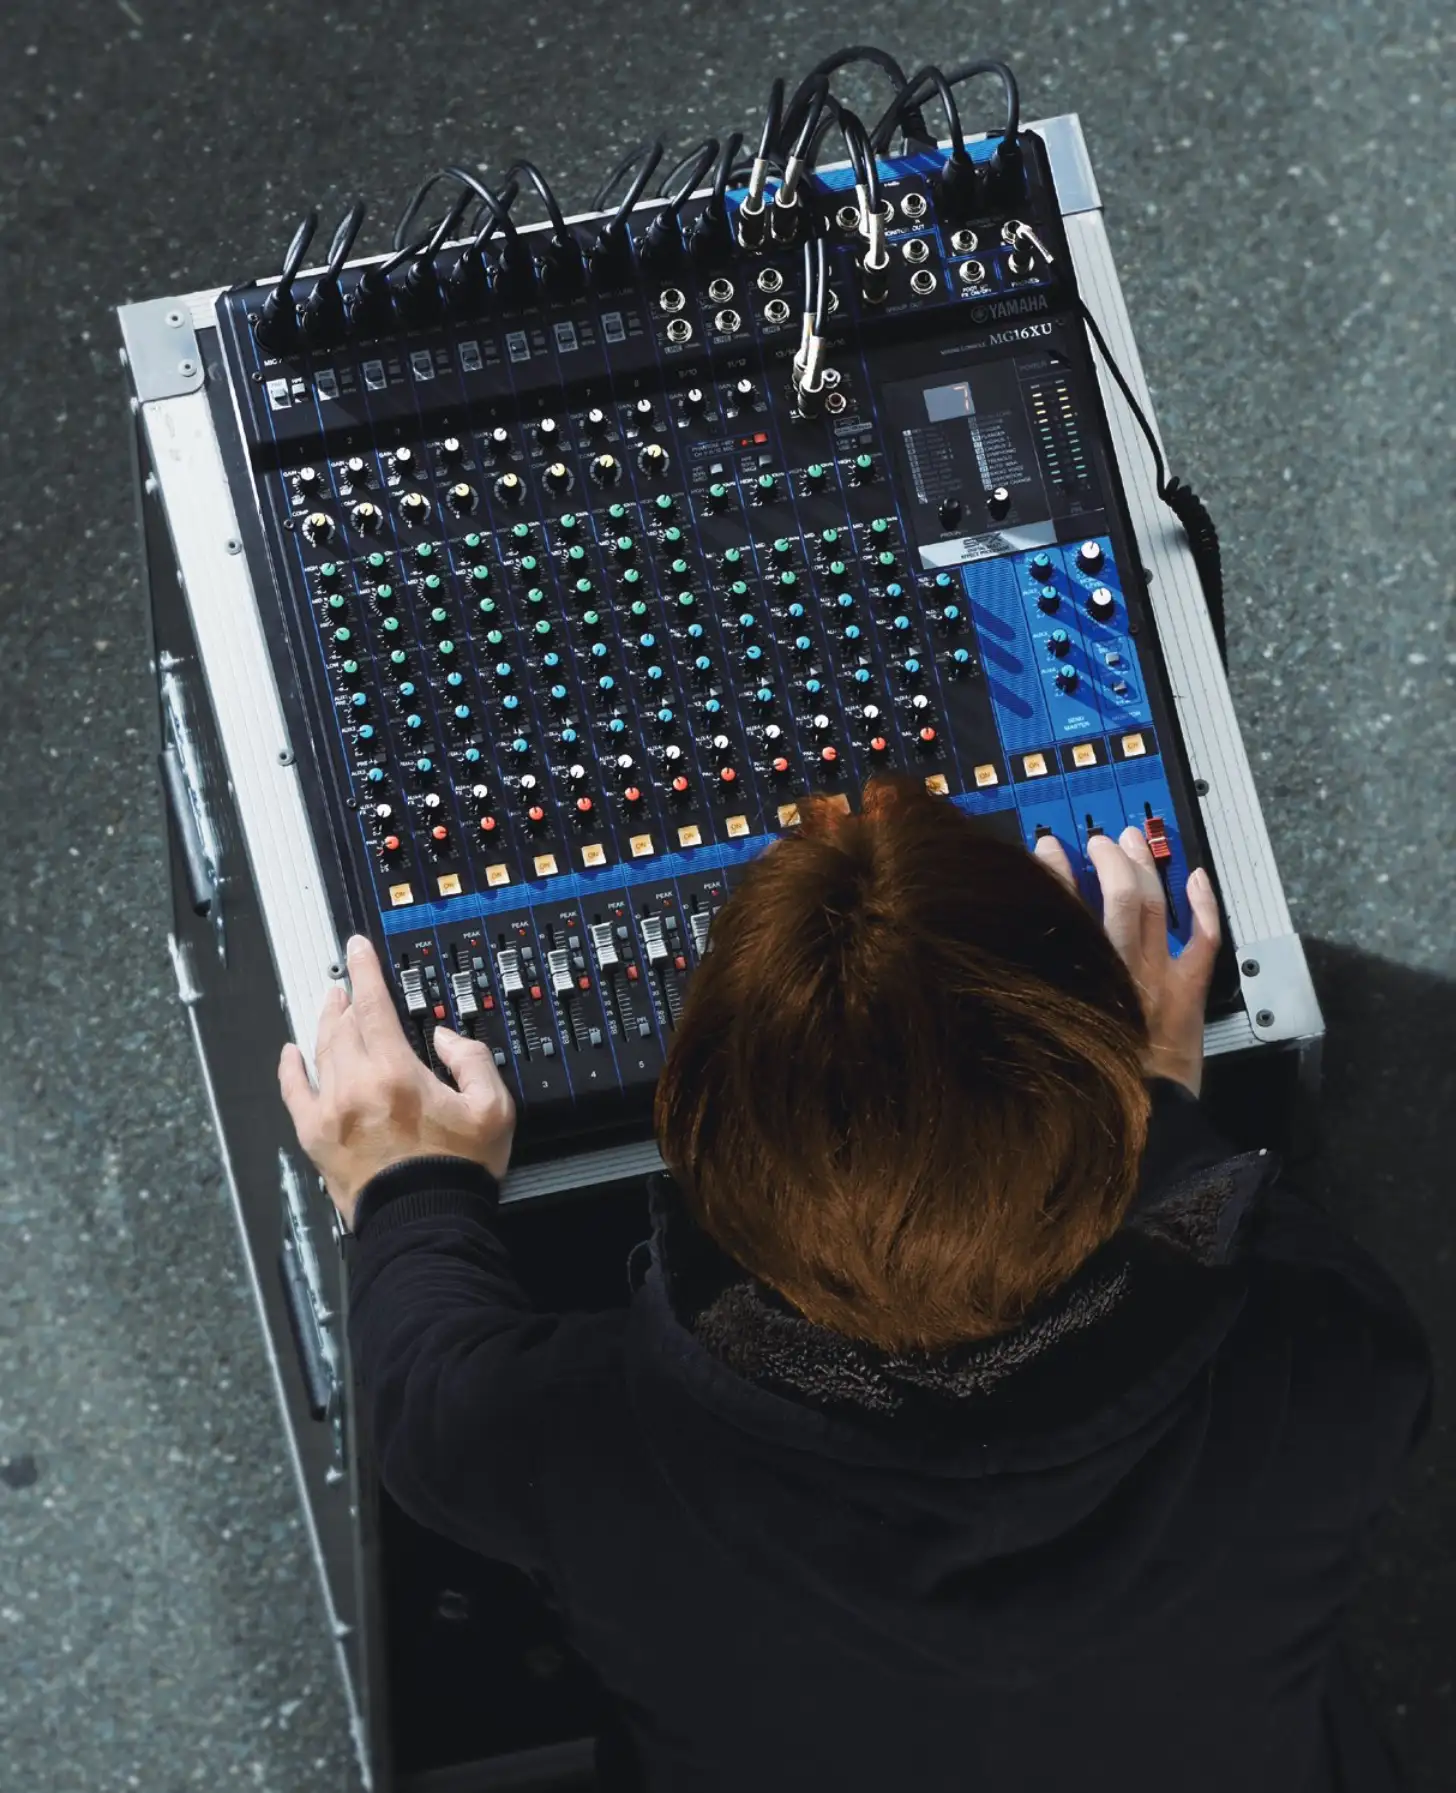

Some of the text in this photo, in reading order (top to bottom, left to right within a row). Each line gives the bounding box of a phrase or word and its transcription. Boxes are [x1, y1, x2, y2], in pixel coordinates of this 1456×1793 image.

[989, 294, 1048, 321] YAMAHA
[989, 322, 1052, 346] MG16XU
[263, 358, 278, 366] MIC
[1078, 751, 1090, 759] ON
[979, 770, 991, 780] ON
[635, 841, 647, 849] ON
[587, 850, 599, 859] ON
[703, 881, 721, 889] PEAK
[655, 891, 673, 899] PEAK
[462, 931, 481, 939] PEAK
[415, 941, 432, 949] PEAK
